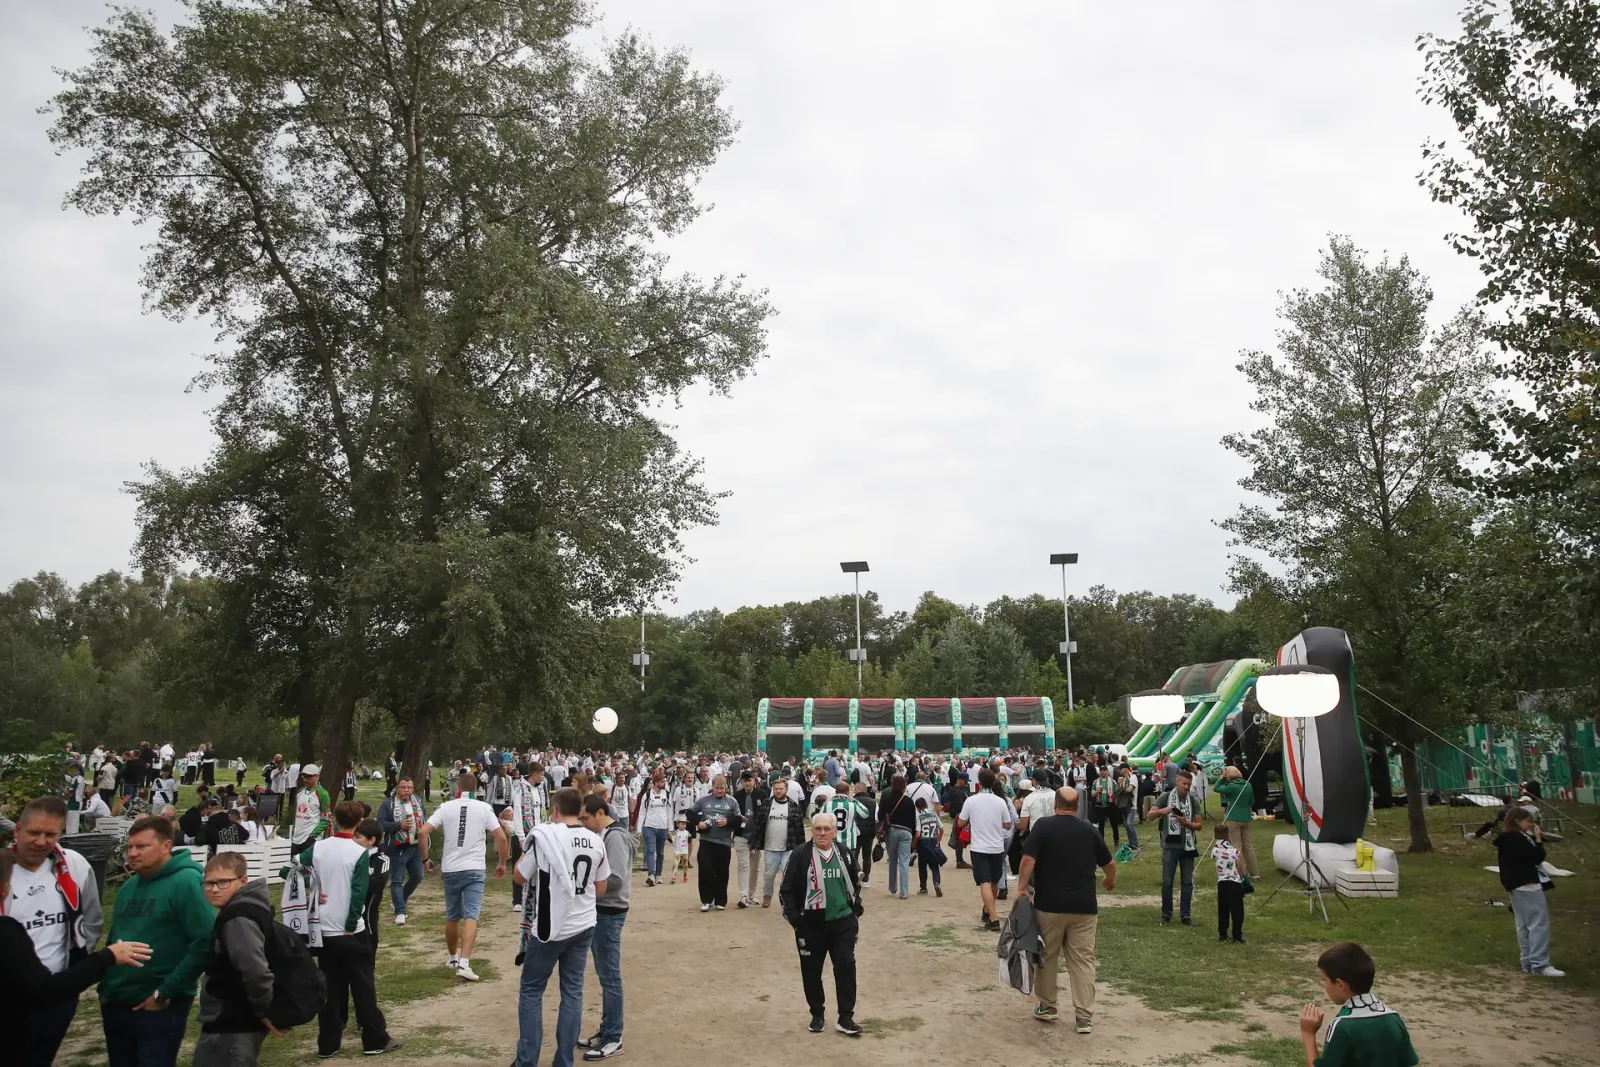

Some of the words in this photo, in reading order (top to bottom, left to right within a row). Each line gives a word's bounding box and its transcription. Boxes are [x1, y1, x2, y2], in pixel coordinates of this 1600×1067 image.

[834, 808, 848, 832] 8
[922, 822, 936, 838] 67
[572, 854, 592, 895] 0
[823, 868, 841, 879] EGIA
